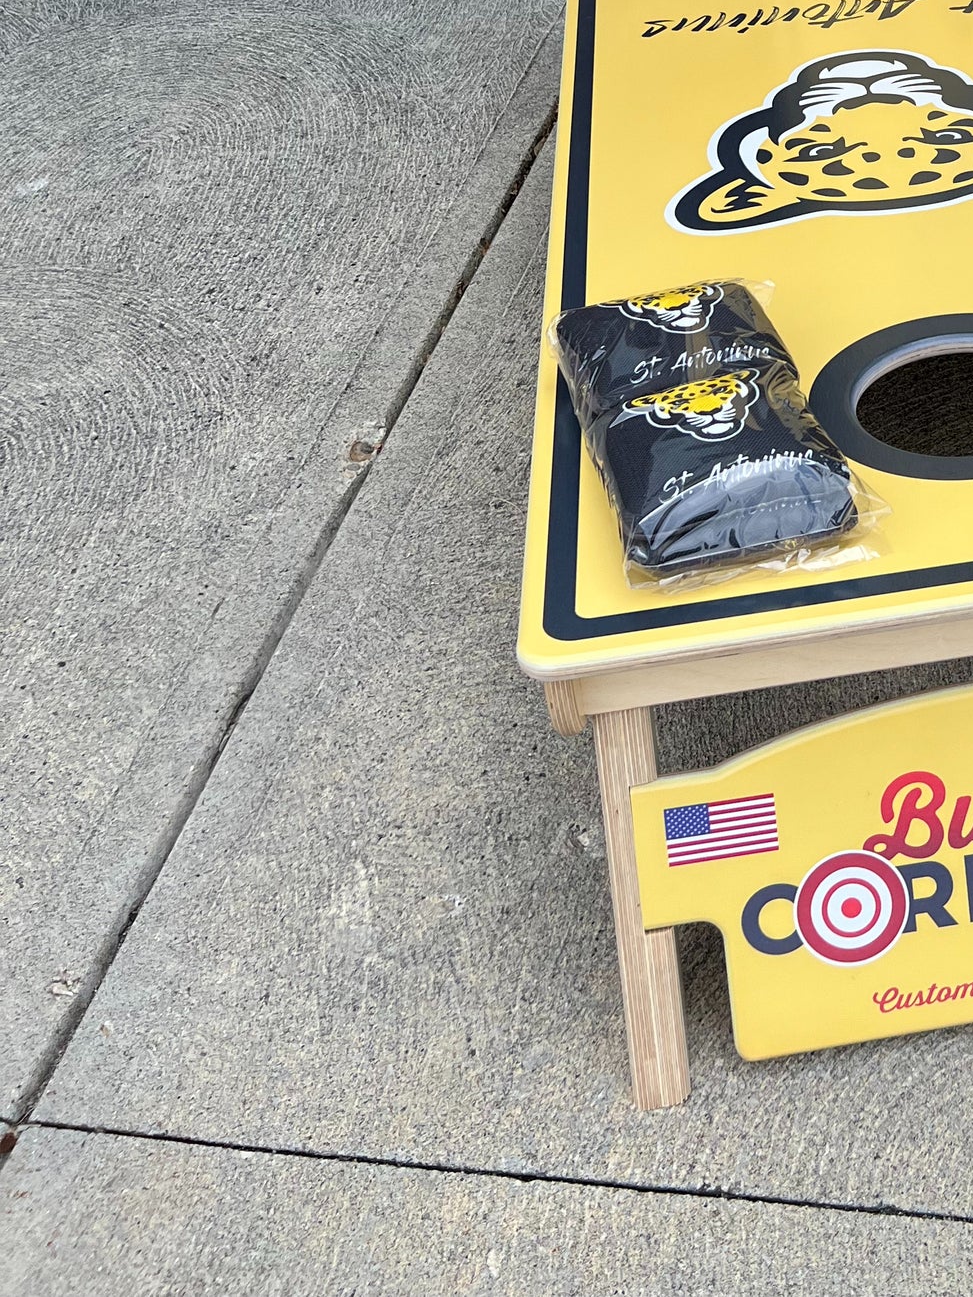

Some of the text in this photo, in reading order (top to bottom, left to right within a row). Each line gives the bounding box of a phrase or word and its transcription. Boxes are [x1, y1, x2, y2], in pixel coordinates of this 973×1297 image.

[629, 342, 771, 385] St. Antoninus
[658, 448, 816, 505] St. Antoninus
